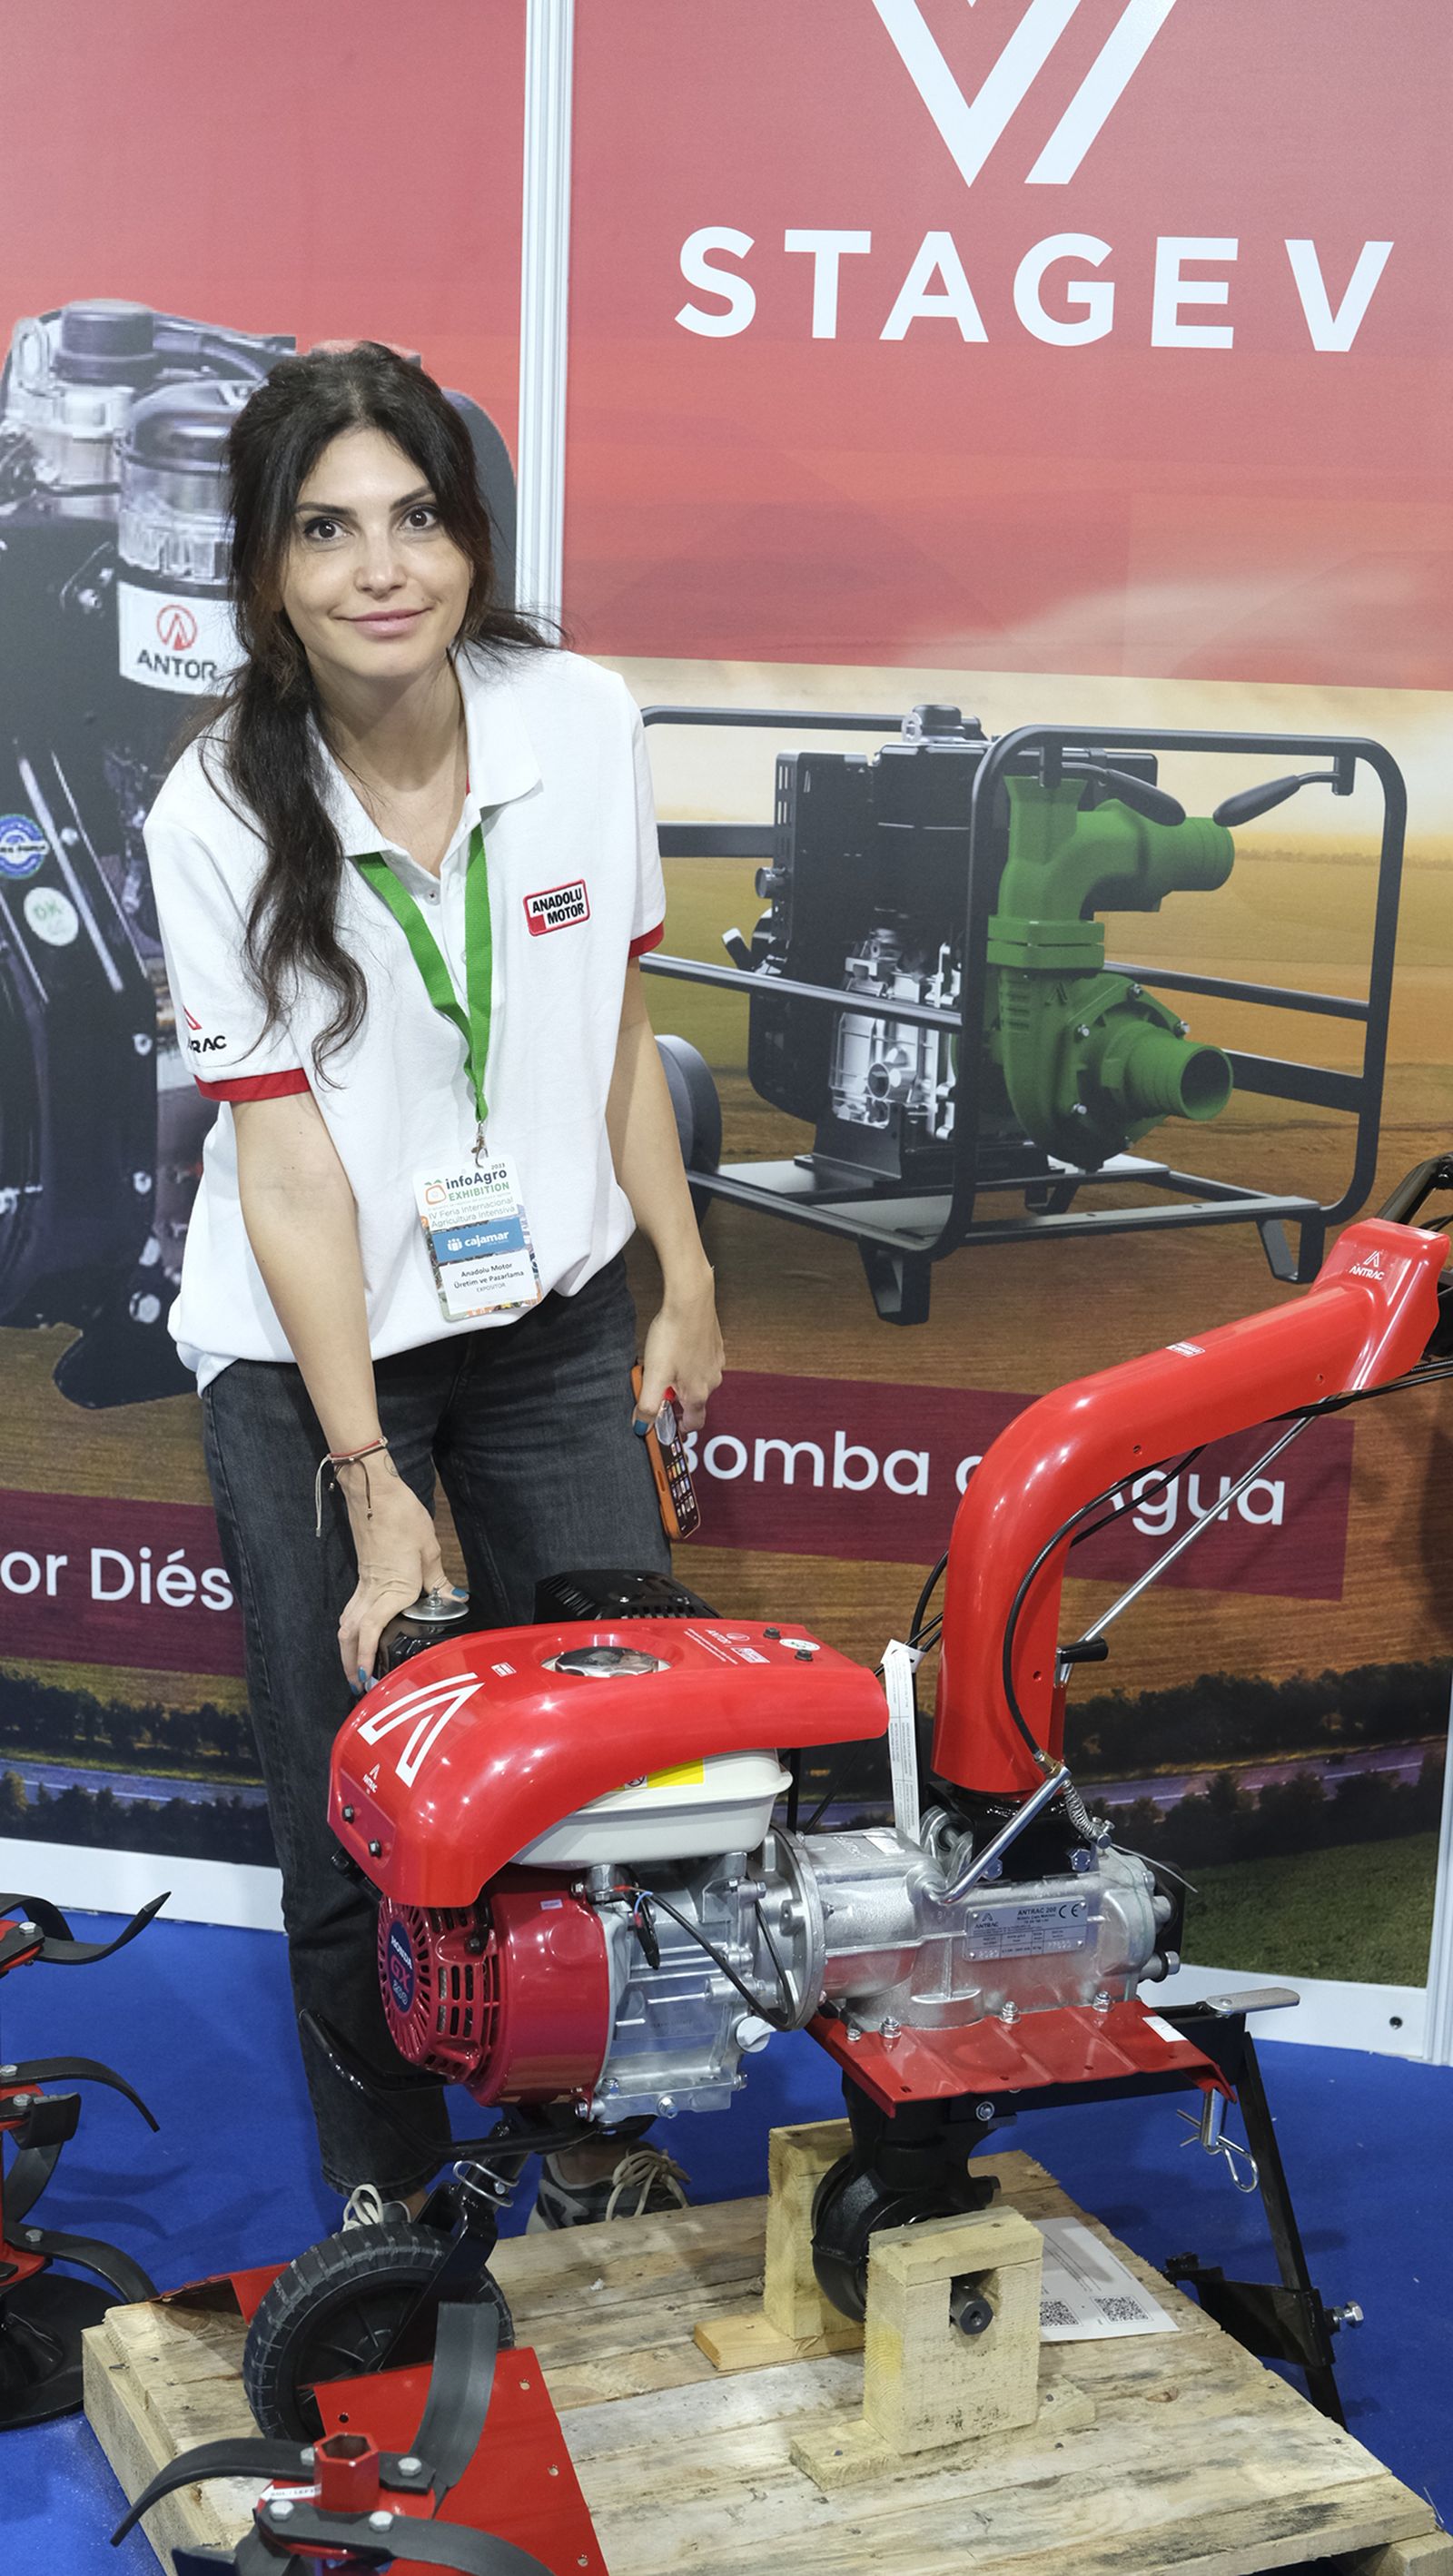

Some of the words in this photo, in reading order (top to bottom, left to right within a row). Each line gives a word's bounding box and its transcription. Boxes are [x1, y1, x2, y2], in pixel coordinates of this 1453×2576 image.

[674, 225, 1239, 349] STAGE
[1284, 239, 1395, 352] V
[137, 648, 219, 682] ANTOR
[532, 887, 583, 914] ANADOLU
[547, 902, 585, 925] MOTOR
[188, 1034, 227, 1053] RAC
[445, 1170, 508, 1189] infoAgro
[449, 1181, 510, 1202] EXHIBITION
[430, 1212, 478, 1229] Agricultura
[478, 1205, 516, 1219] Intensiva
[440, 1208, 460, 1218] Feria
[461, 1197, 514, 1213] Internacional
[464, 1231, 509, 1248] cajamar
[454, 1279, 479, 1289] Üretim
[489, 1271, 524, 1282] Pazarlama
[460, 1267, 490, 1278] Anadolu
[490, 1263, 512, 1271] Motor
[1349, 1265, 1385, 1280] ANTRAC
[0, 1550, 68, 1596] or
[91, 1546, 234, 1612] Diés
